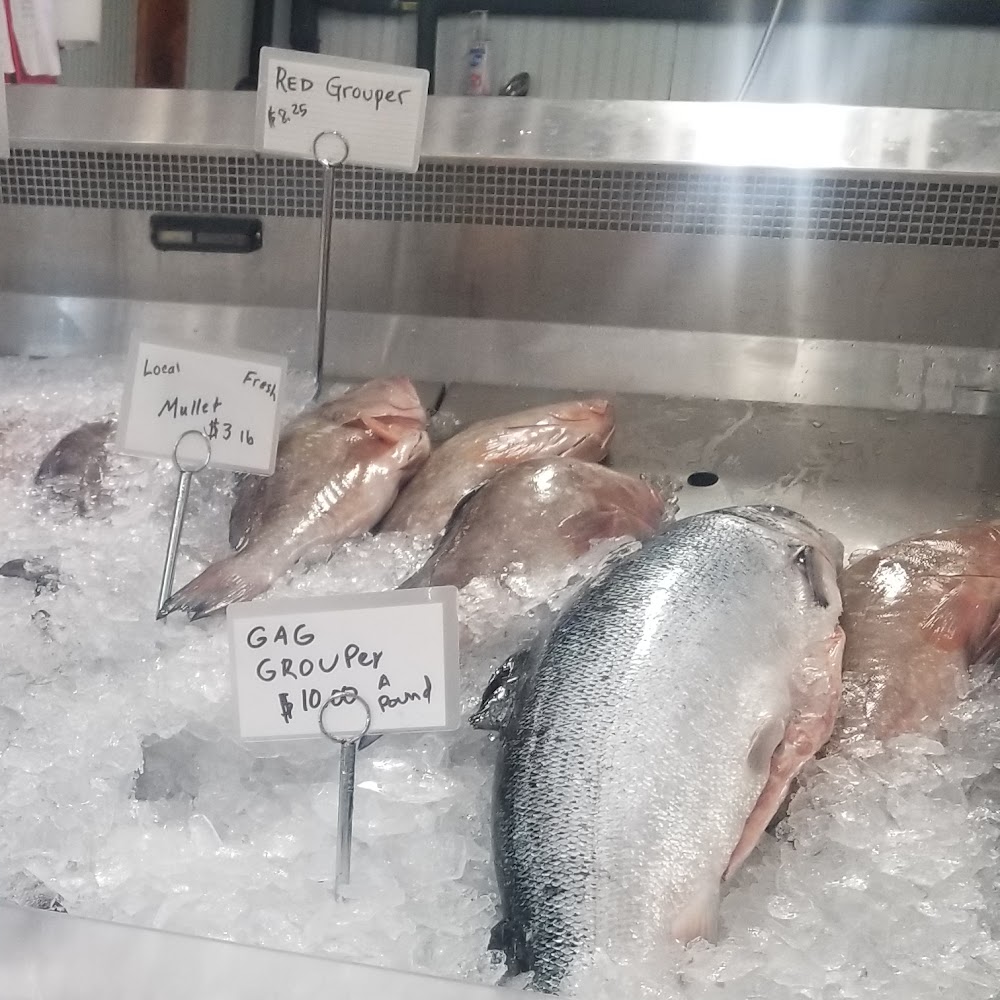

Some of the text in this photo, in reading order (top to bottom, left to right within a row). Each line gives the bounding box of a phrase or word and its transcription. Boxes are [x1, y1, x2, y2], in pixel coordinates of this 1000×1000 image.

[275, 66, 411, 111] RED Grouper
[143, 359, 277, 402] Local Fresh
[157, 396, 223, 419] Mullet
[208, 417, 233, 441] $3
[246, 623, 316, 649] GAG
